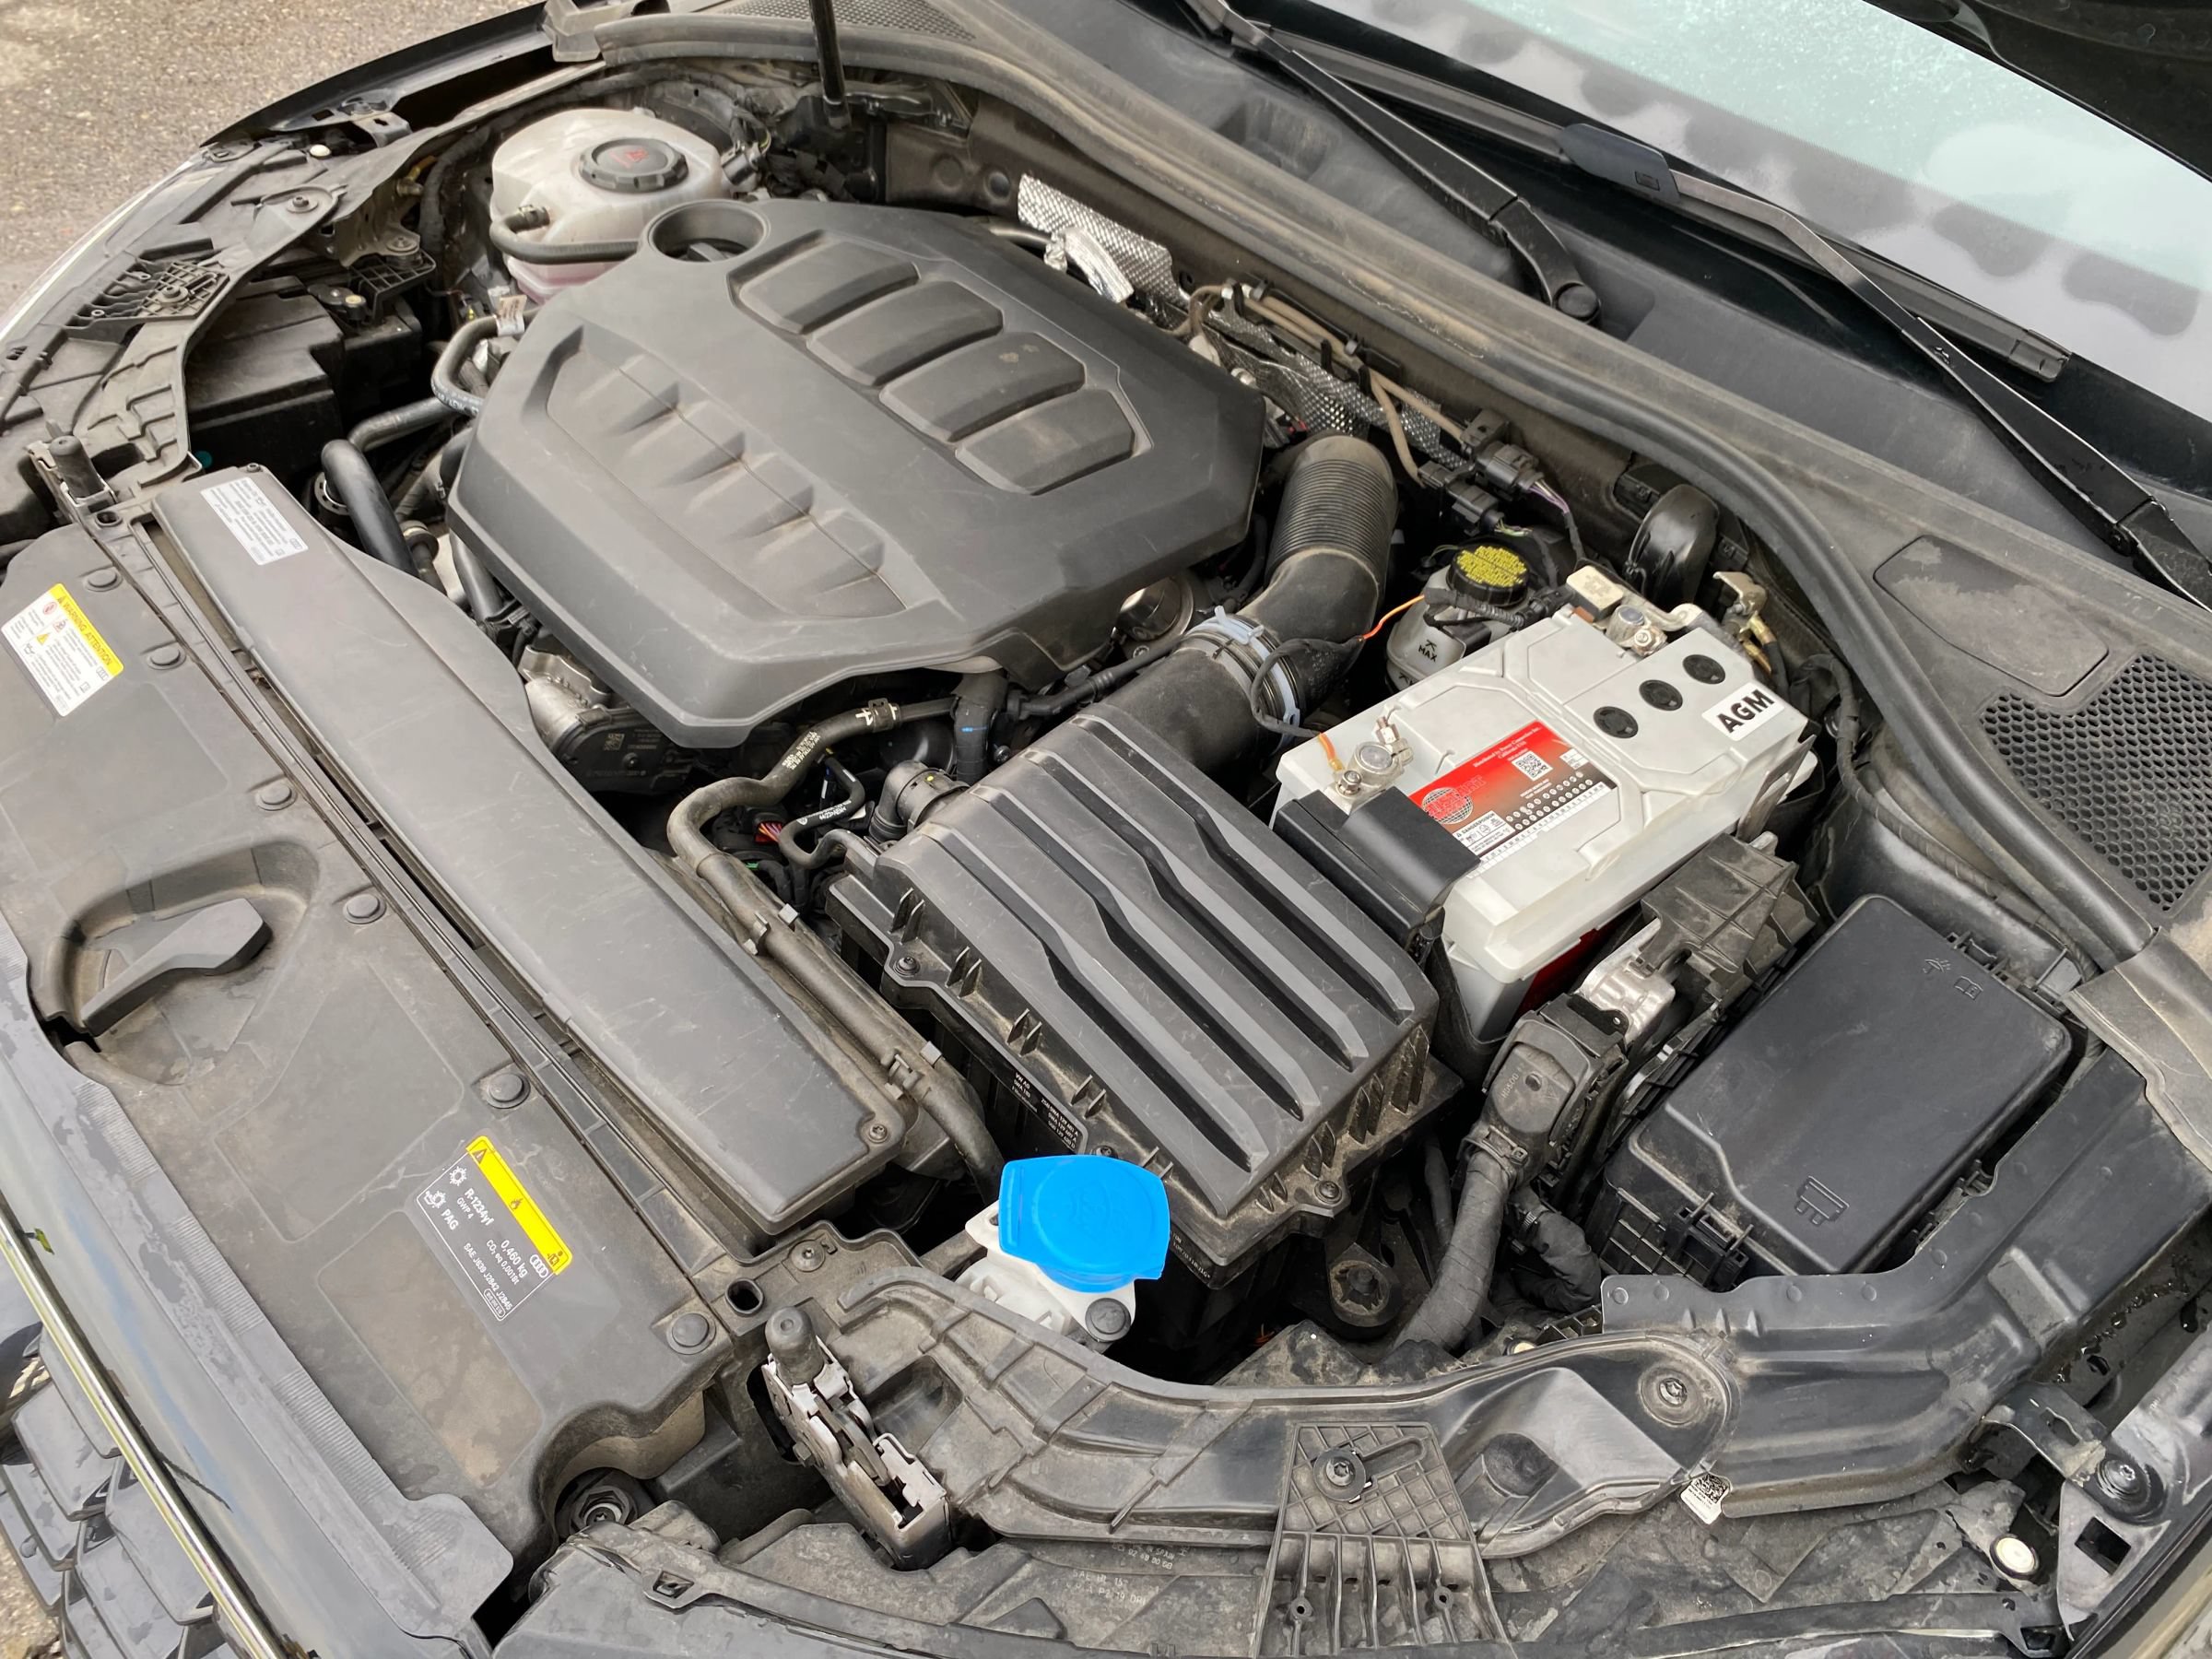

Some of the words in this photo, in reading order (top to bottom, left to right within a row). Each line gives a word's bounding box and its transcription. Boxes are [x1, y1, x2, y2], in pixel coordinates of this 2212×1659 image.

[86, 630, 112, 665] ATTENTION
[1418, 644, 1438, 663] MAX
[1716, 688, 1775, 734] AGM
[441, 1208, 460, 1230] PAG
[456, 1197, 471, 1215] GWP
[464, 1187, 495, 1227] R-1234yf
[463, 1242, 477, 1258] SAE
[500, 1239, 522, 1266] 0,460
[516, 1261, 529, 1278] kg
